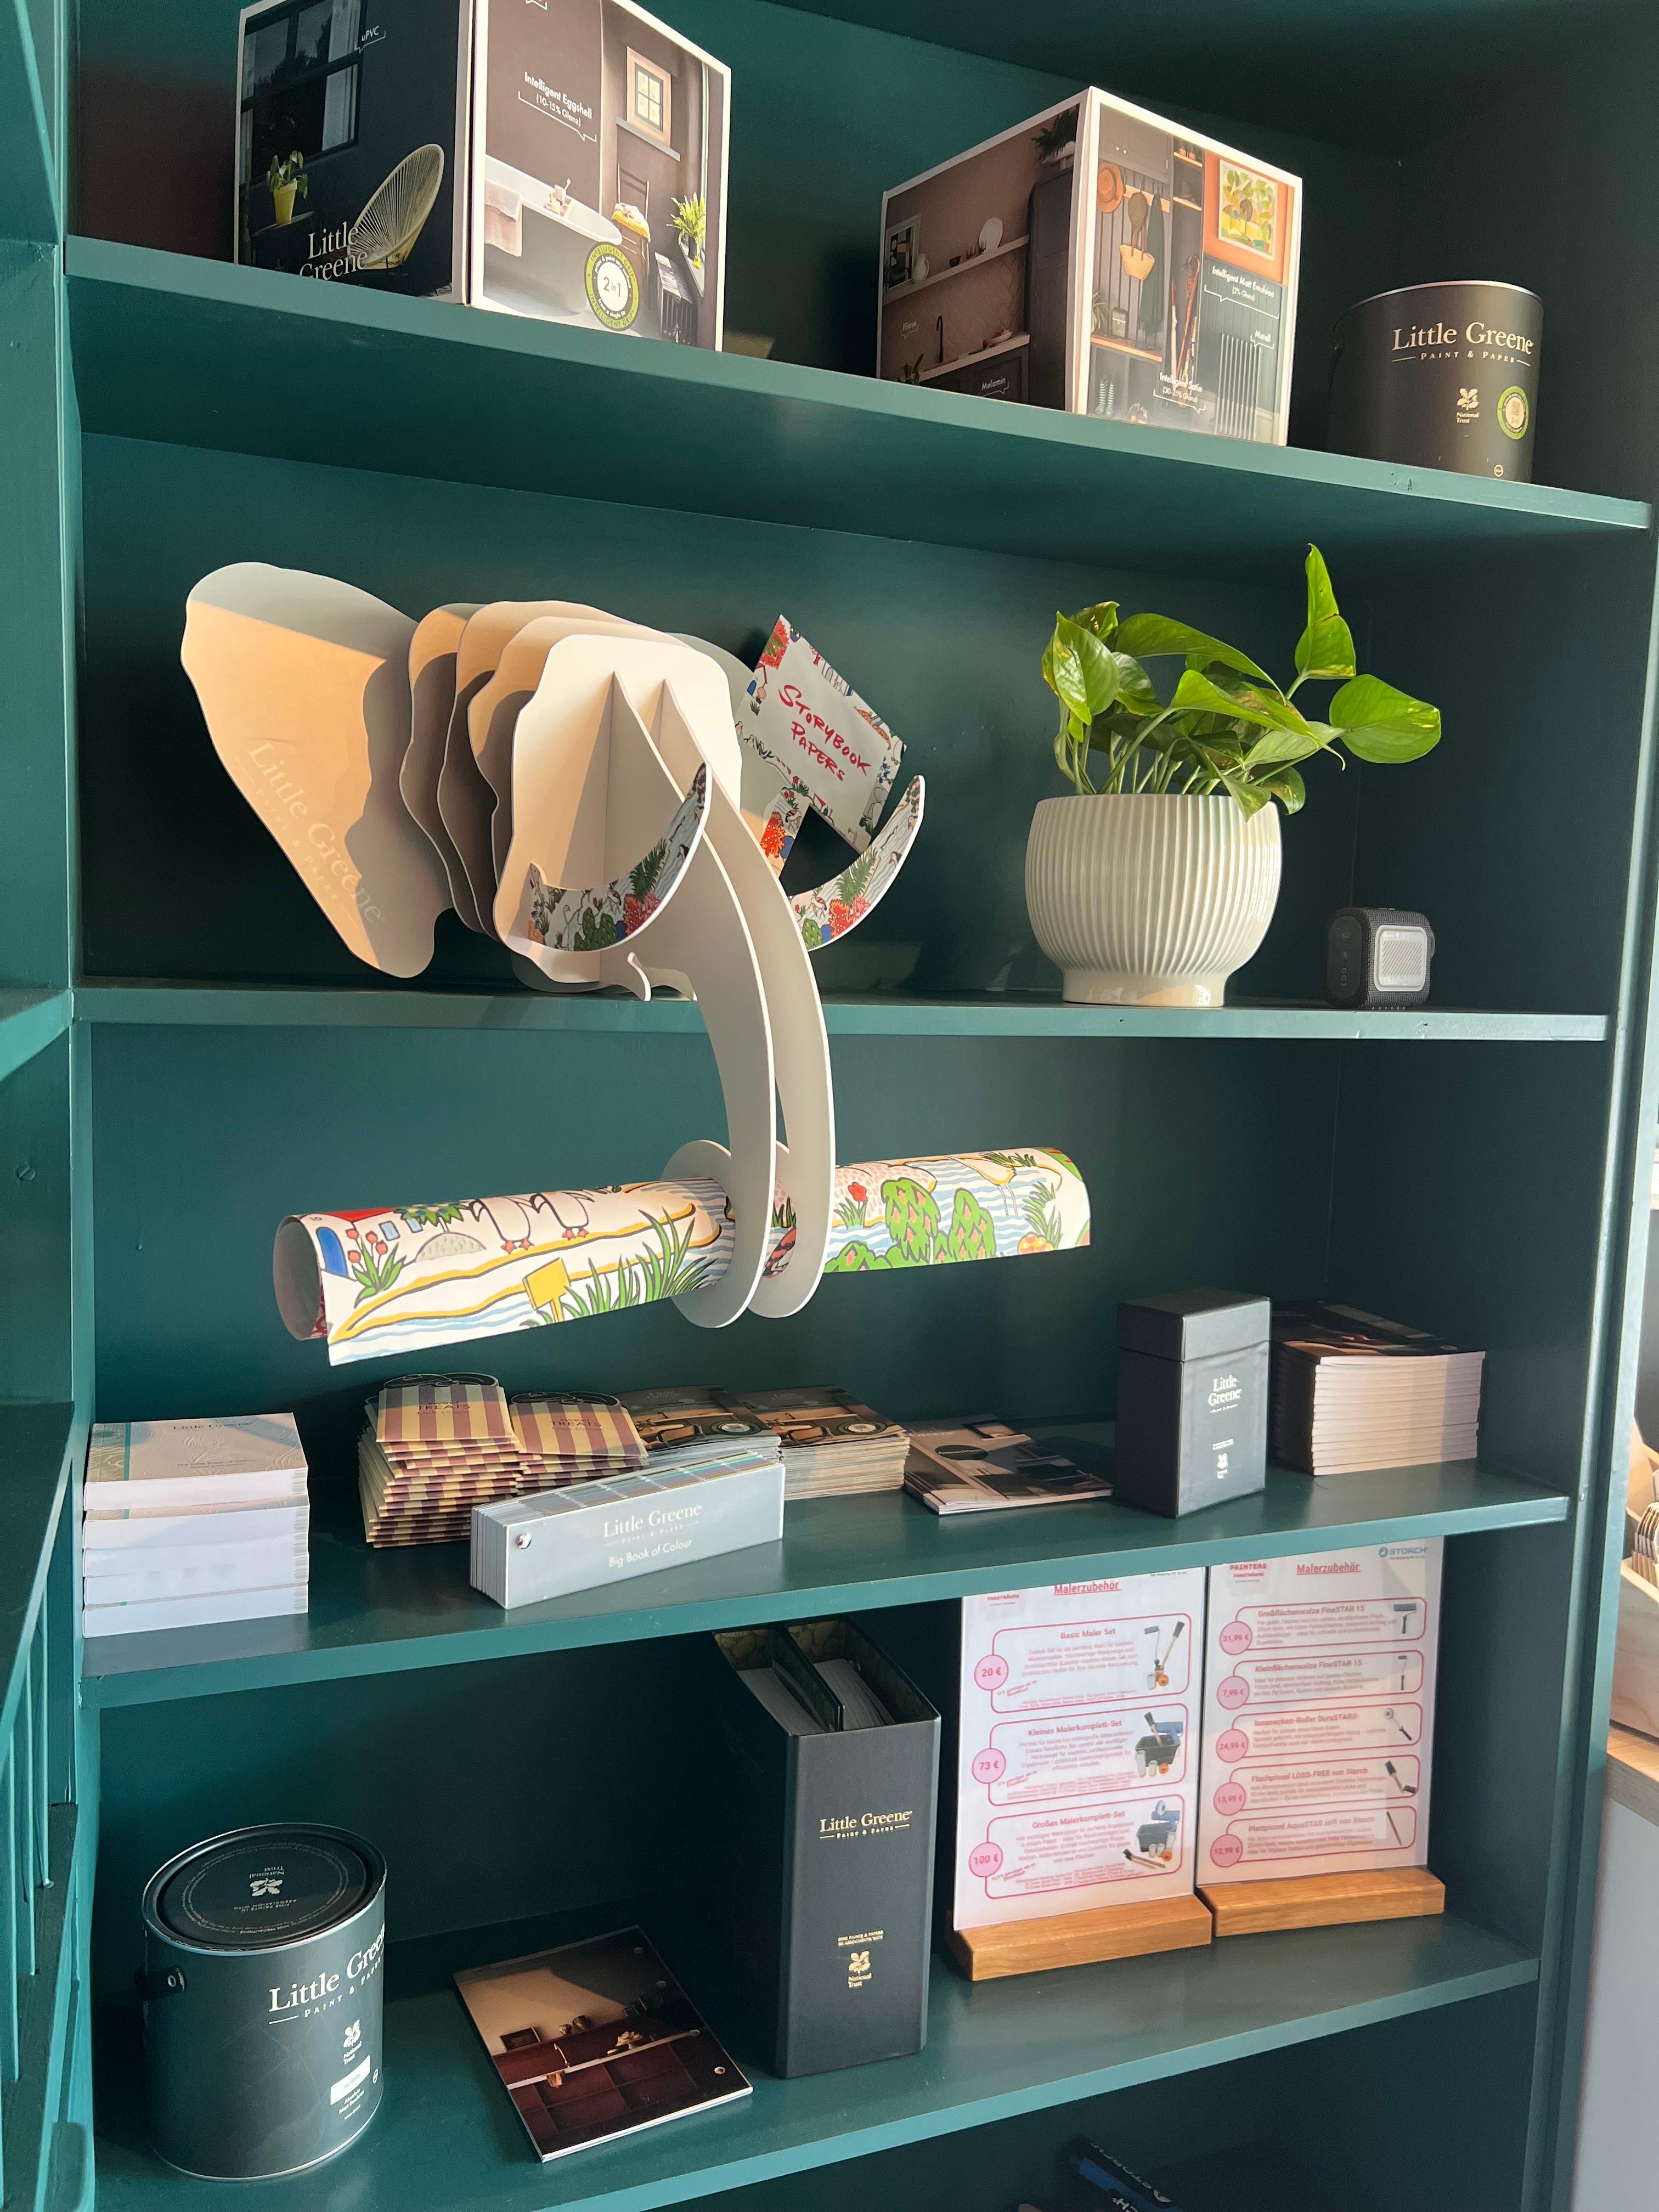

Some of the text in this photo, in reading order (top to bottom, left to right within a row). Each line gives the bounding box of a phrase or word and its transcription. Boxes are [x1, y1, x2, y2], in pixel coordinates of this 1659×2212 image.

[362, 26, 379, 41] uPVC
[524, 71, 592, 119] Intelligent Eggshell
[536, 93, 561, 115] (10-15%
[308, 221, 359, 259] Little
[603, 276, 622, 297] 2 in 1
[1212, 266, 1239, 283] Intelligent
[1252, 281, 1274, 298] Emulsion
[590, 294, 621, 327] INTELLIGENT
[1392, 321, 1533, 355] Little Greene
[1420, 350, 1515, 363] PAINT & PAPER
[981, 376, 1006, 391] Melamin
[1159, 372, 1188, 387] Intelligent
[778, 684, 872, 776] STORYBOOK
[790, 720, 846, 782] PAPERS
[246, 741, 382, 923] Little Greene
[1212, 1374, 1238, 1392] Little
[1208, 1388, 1242, 1407] Greene
[603, 1505, 701, 1537] Little Greene
[609, 1539, 693, 1568] Big Book of Colour
[1390, 1547, 1428, 1555] STORCH
[1296, 1561, 1359, 1574] Malerzubehör
[1054, 1581, 1119, 1594] Malerzubehör
[1322, 1606, 1354, 1615] FineSTAR
[1060, 1628, 1115, 1640] Basic Maler Set
[981, 1667, 1001, 1677] 20 €
[1319, 1660, 1351, 1669] FineSTAR
[1029, 1720, 1122, 1736] Kleines Malerkomplett-Set
[979, 1760, 999, 1770] 73 €
[1292, 1770, 1330, 1780] LOSS-FREE
[1346, 1767, 1368, 1775] Storch
[820, 1811, 912, 1832] Little Greene
[1032, 1811, 1126, 1830] Großes Malerkomplett-Set
[973, 1854, 999, 1865] 100 €
[249, 1870, 285, 1879] National
[268, 1971, 340, 2012] Little
[304, 1995, 342, 2018] PAINT
[349, 1985, 355, 1995] &
